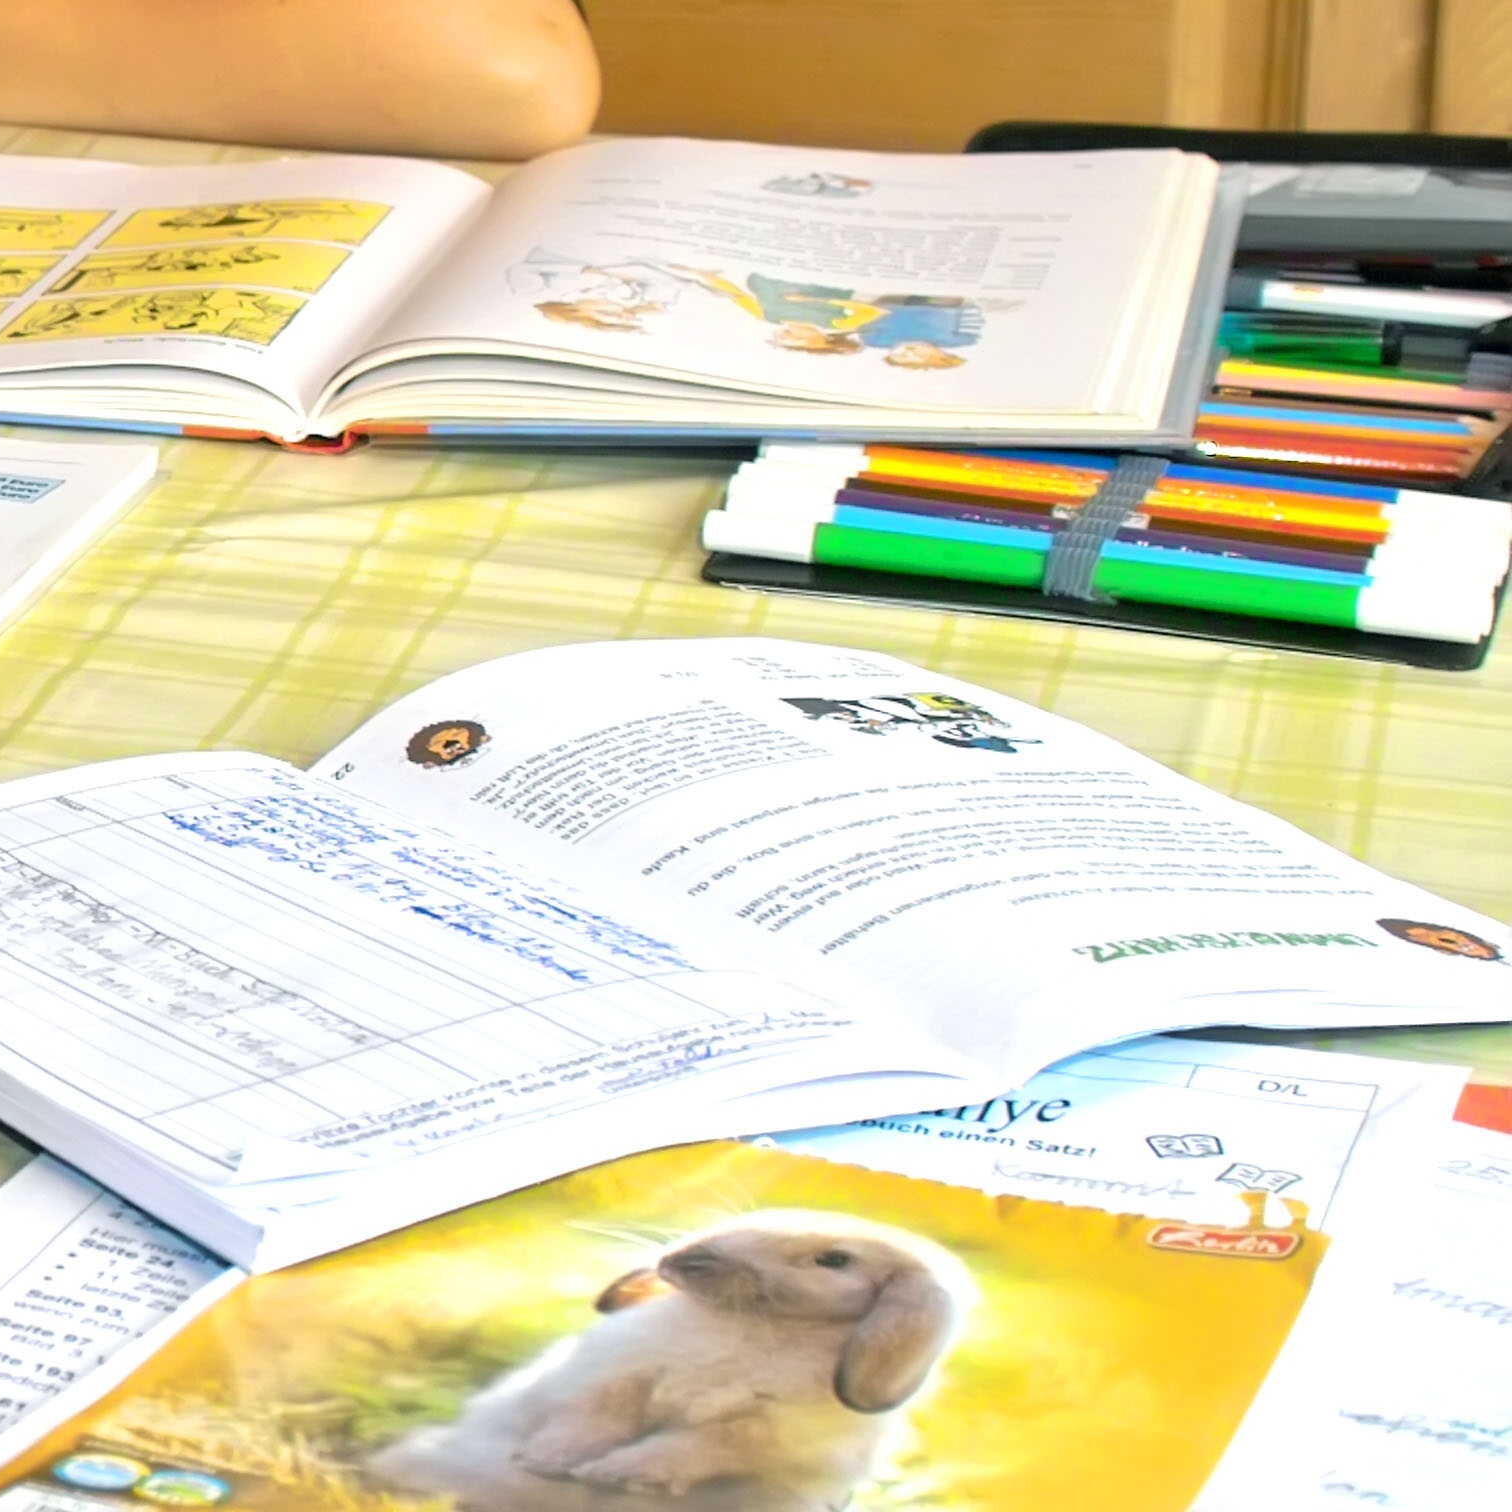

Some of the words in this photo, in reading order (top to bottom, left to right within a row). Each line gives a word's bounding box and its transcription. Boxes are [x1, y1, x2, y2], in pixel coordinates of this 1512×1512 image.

[0, 484, 41, 495] Euro
[10, 478, 50, 489] Euro
[533, 806, 566, 830] dem
[640, 845, 691, 878] Kaufe
[710, 864, 739, 881] die
[685, 879, 712, 897] du
[750, 904, 790, 926] Wer
[768, 904, 814, 933] einen
[818, 914, 891, 957] Behälter
[502, 1079, 557, 1097] Teile
[560, 1068, 591, 1082] der
[1258, 1078, 1310, 1099] D/L
[362, 1098, 437, 1126] Tochter
[442, 1078, 513, 1102] konnte
[938, 1128, 1016, 1148] einen
[1025, 1138, 1098, 1159] Satz!
[89, 1226, 136, 1246] Hier
[77, 1237, 139, 1261] Seite
[131, 1265, 189, 1288] Zeile
[24, 1288, 87, 1309] Seite
[78, 1282, 142, 1304] letzte
[132, 1281, 191, 1303] Zeile
[12, 1300, 75, 1320] wenn
[79, 1315, 130, 1337] zum
[9, 1332, 57, 1352] Bild
[62, 1332, 95, 1348] 97
[33, 1362, 76, 1383] 193
